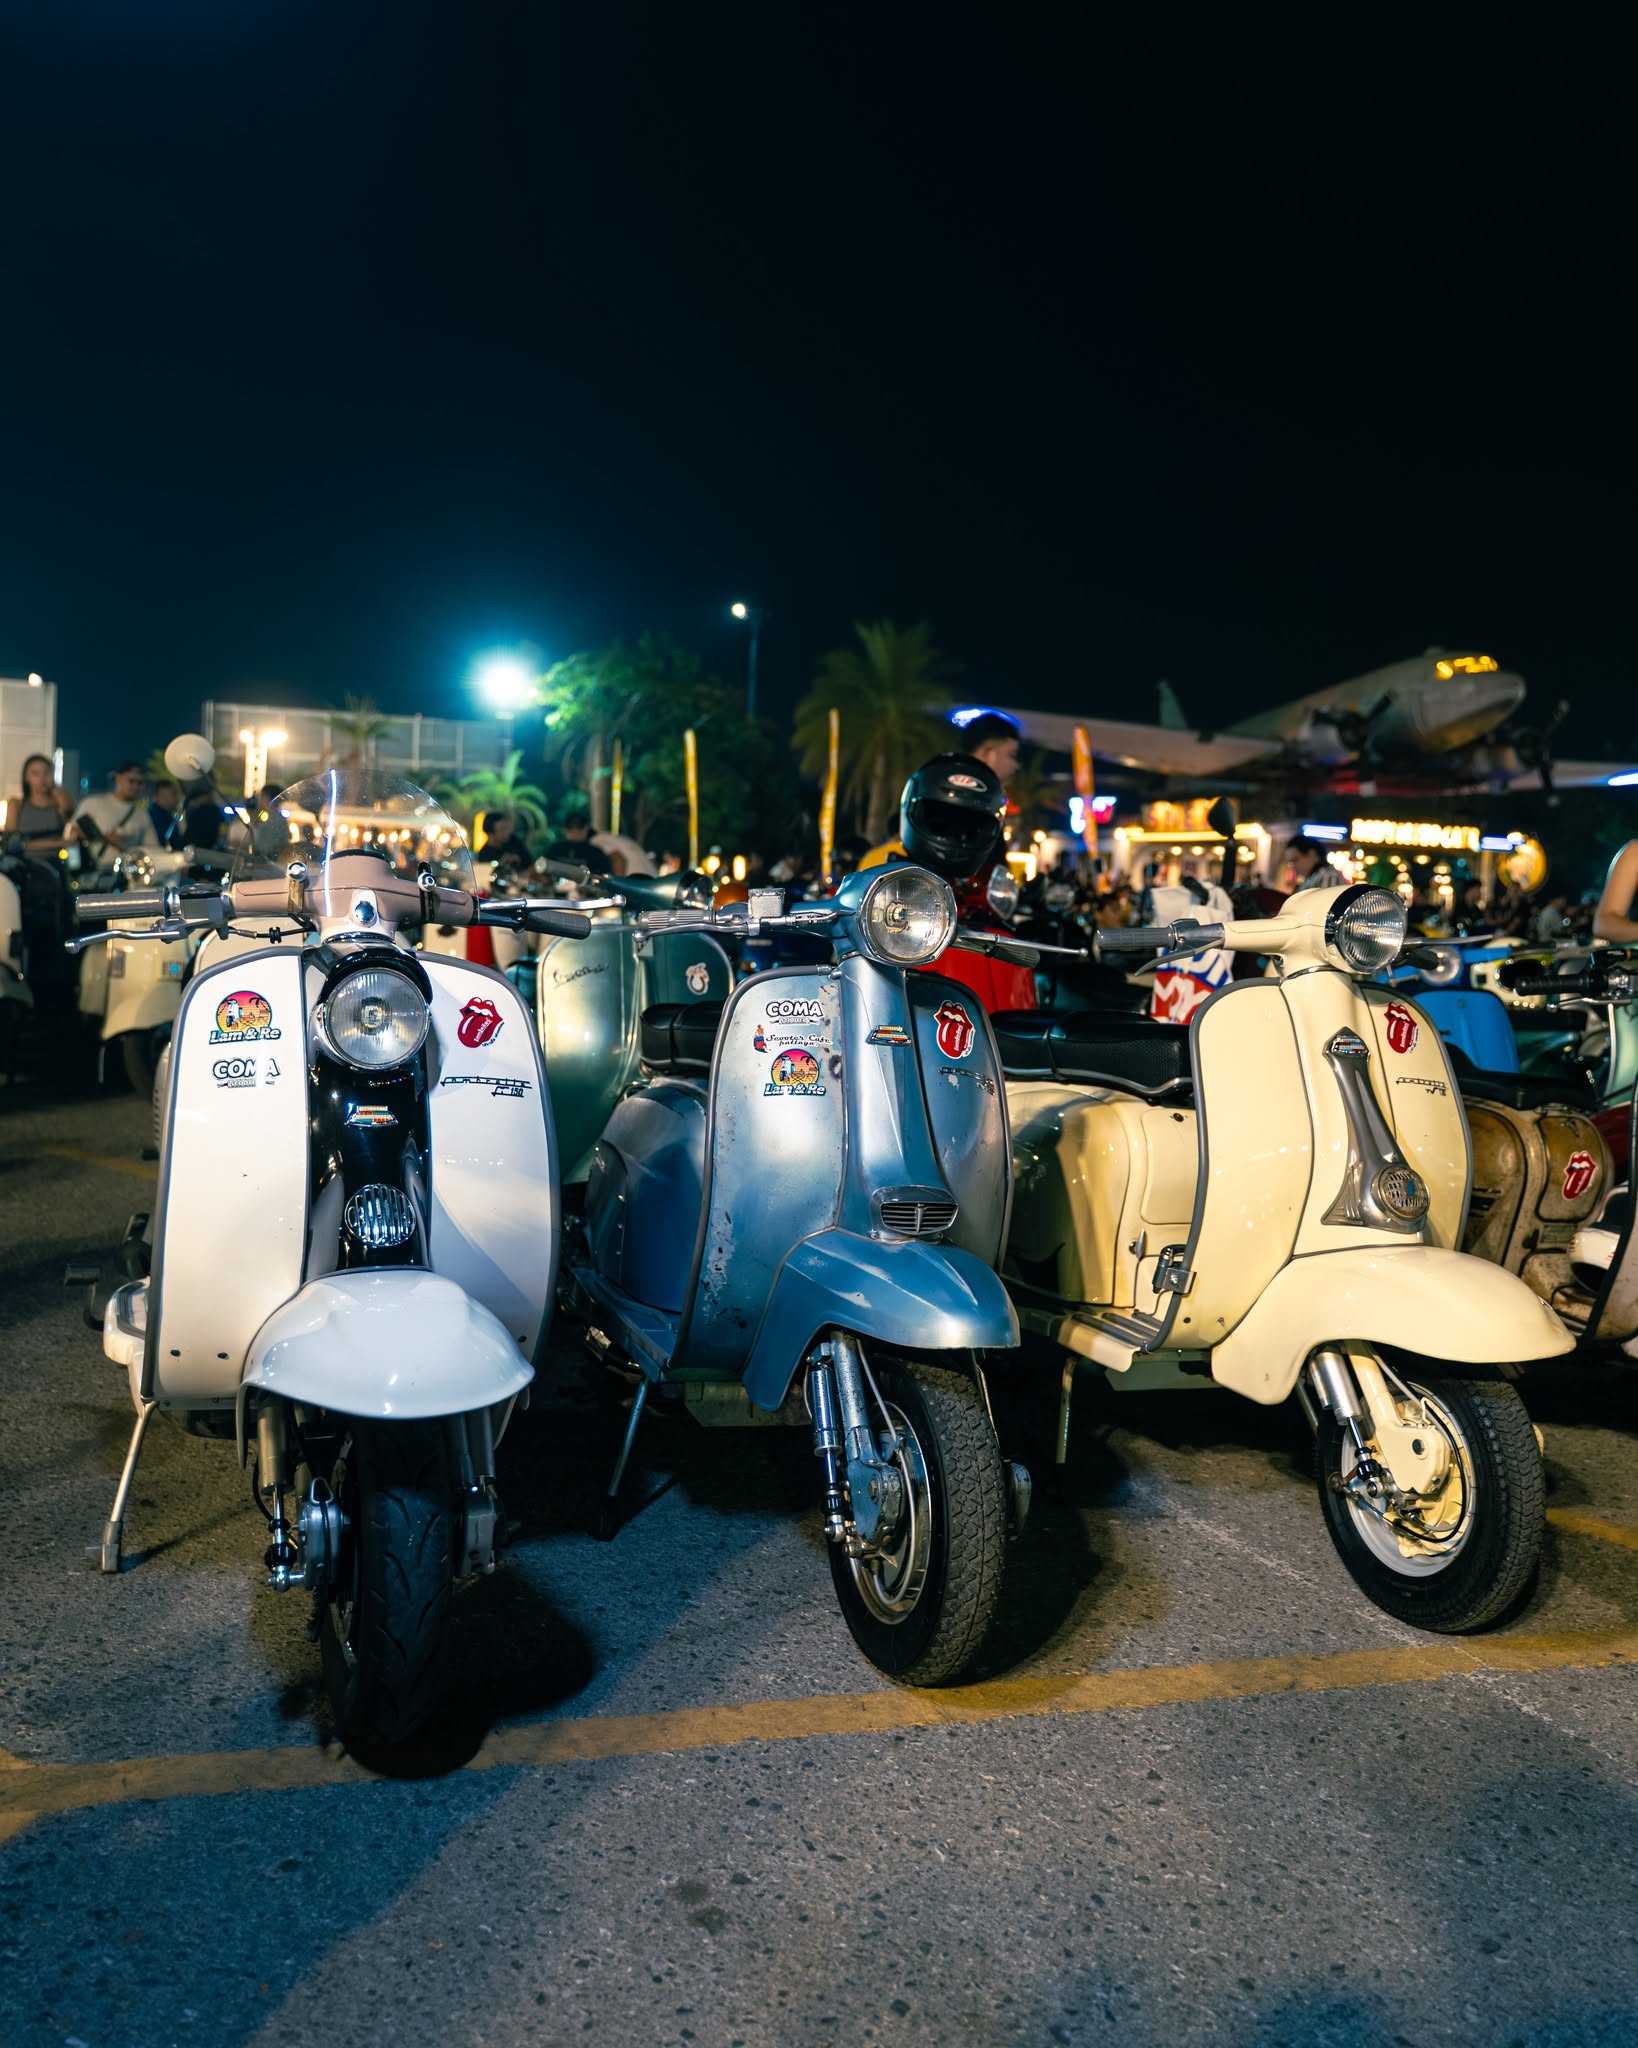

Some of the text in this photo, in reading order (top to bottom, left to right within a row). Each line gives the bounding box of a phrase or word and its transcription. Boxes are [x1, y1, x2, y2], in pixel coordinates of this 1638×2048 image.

[766, 1000, 823, 1018] COMA
[209, 1026, 281, 1044] Lam & Re
[766, 1034, 804, 1042] Scooter
[213, 1058, 281, 1080] COMA
[763, 1082, 827, 1096] Lam & Re
